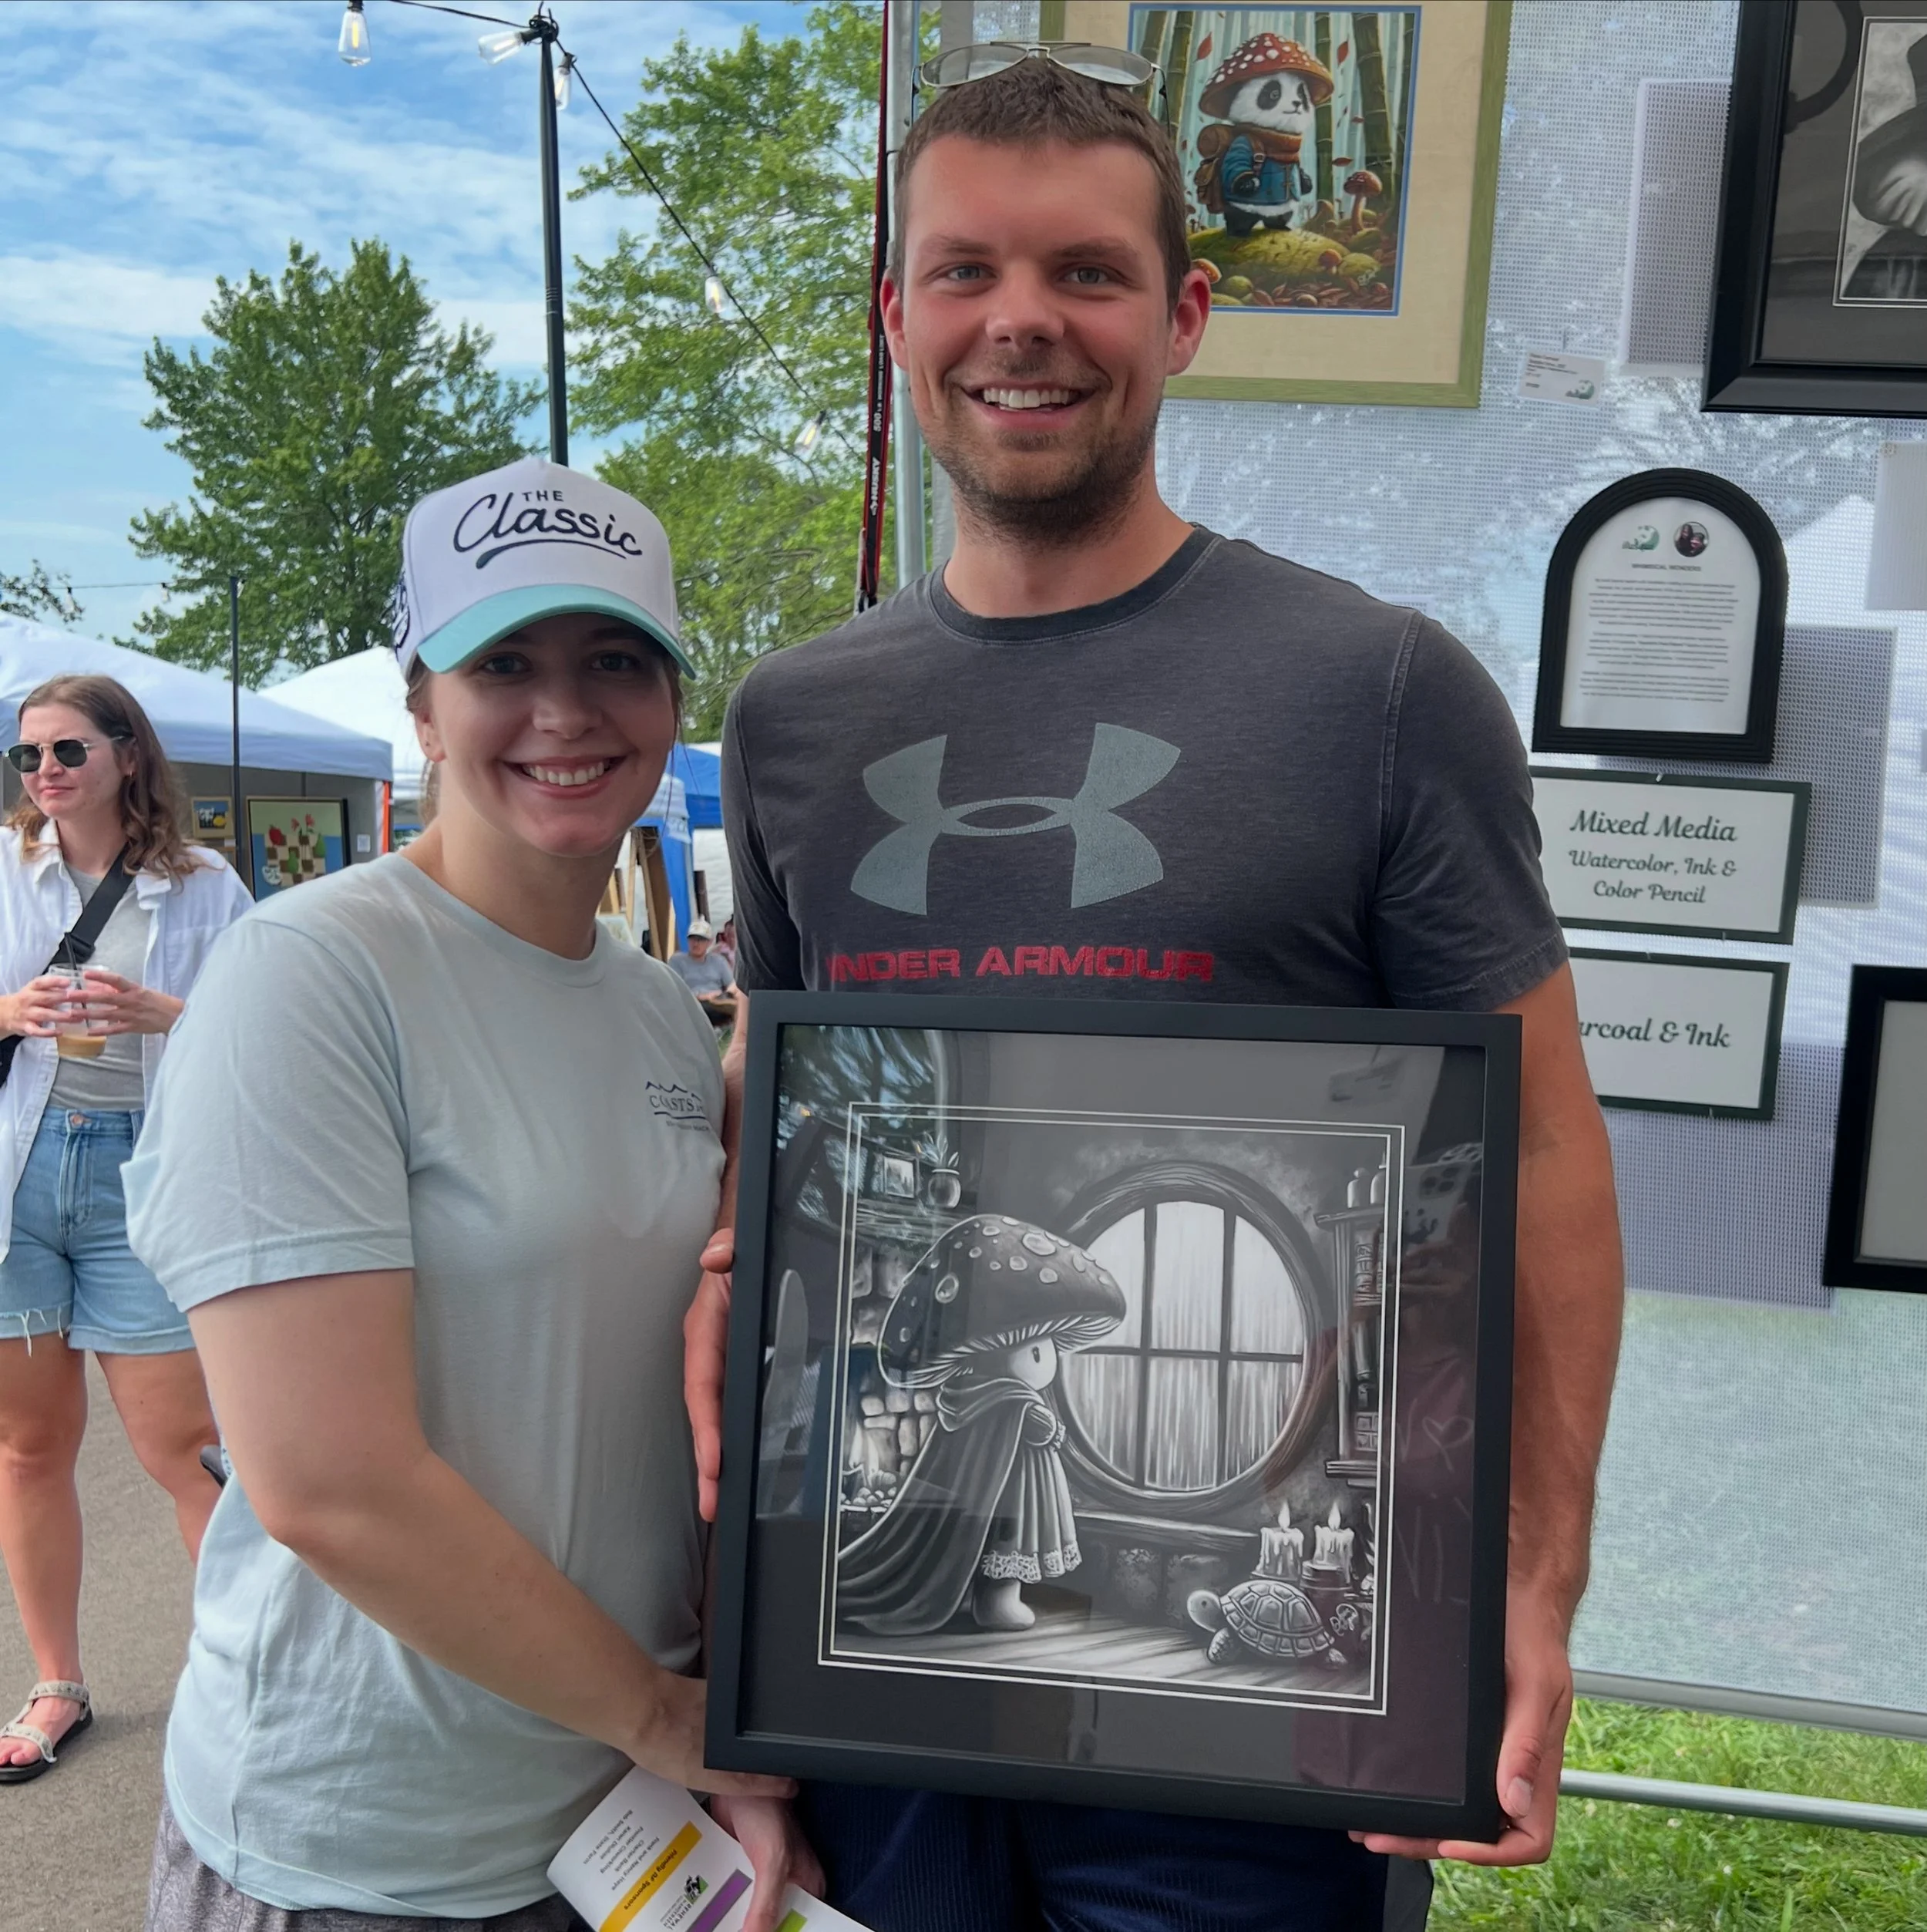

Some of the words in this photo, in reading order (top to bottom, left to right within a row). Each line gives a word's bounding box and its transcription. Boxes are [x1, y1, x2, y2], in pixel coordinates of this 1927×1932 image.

[873, 412, 883, 432] 500
[871, 457, 880, 500] HUSKY
[521, 490, 565, 503] THE
[452, 491, 644, 557] Classic
[1569, 809, 1650, 836] Mixed
[1654, 814, 1737, 842] Media
[1568, 849, 1679, 875] Watercolor,
[1684, 857, 1718, 877] Ink
[1721, 860, 1737, 877] &
[1593, 880, 1643, 900] Color
[1647, 884, 1707, 904] Pencil
[975, 945, 1215, 982] ARMOUR
[1659, 1021, 1680, 1043] &
[1685, 1022, 1731, 1048] Ink
[656, 1849, 678, 1873] Friendly
[624, 1880, 650, 1910] Sponsors
